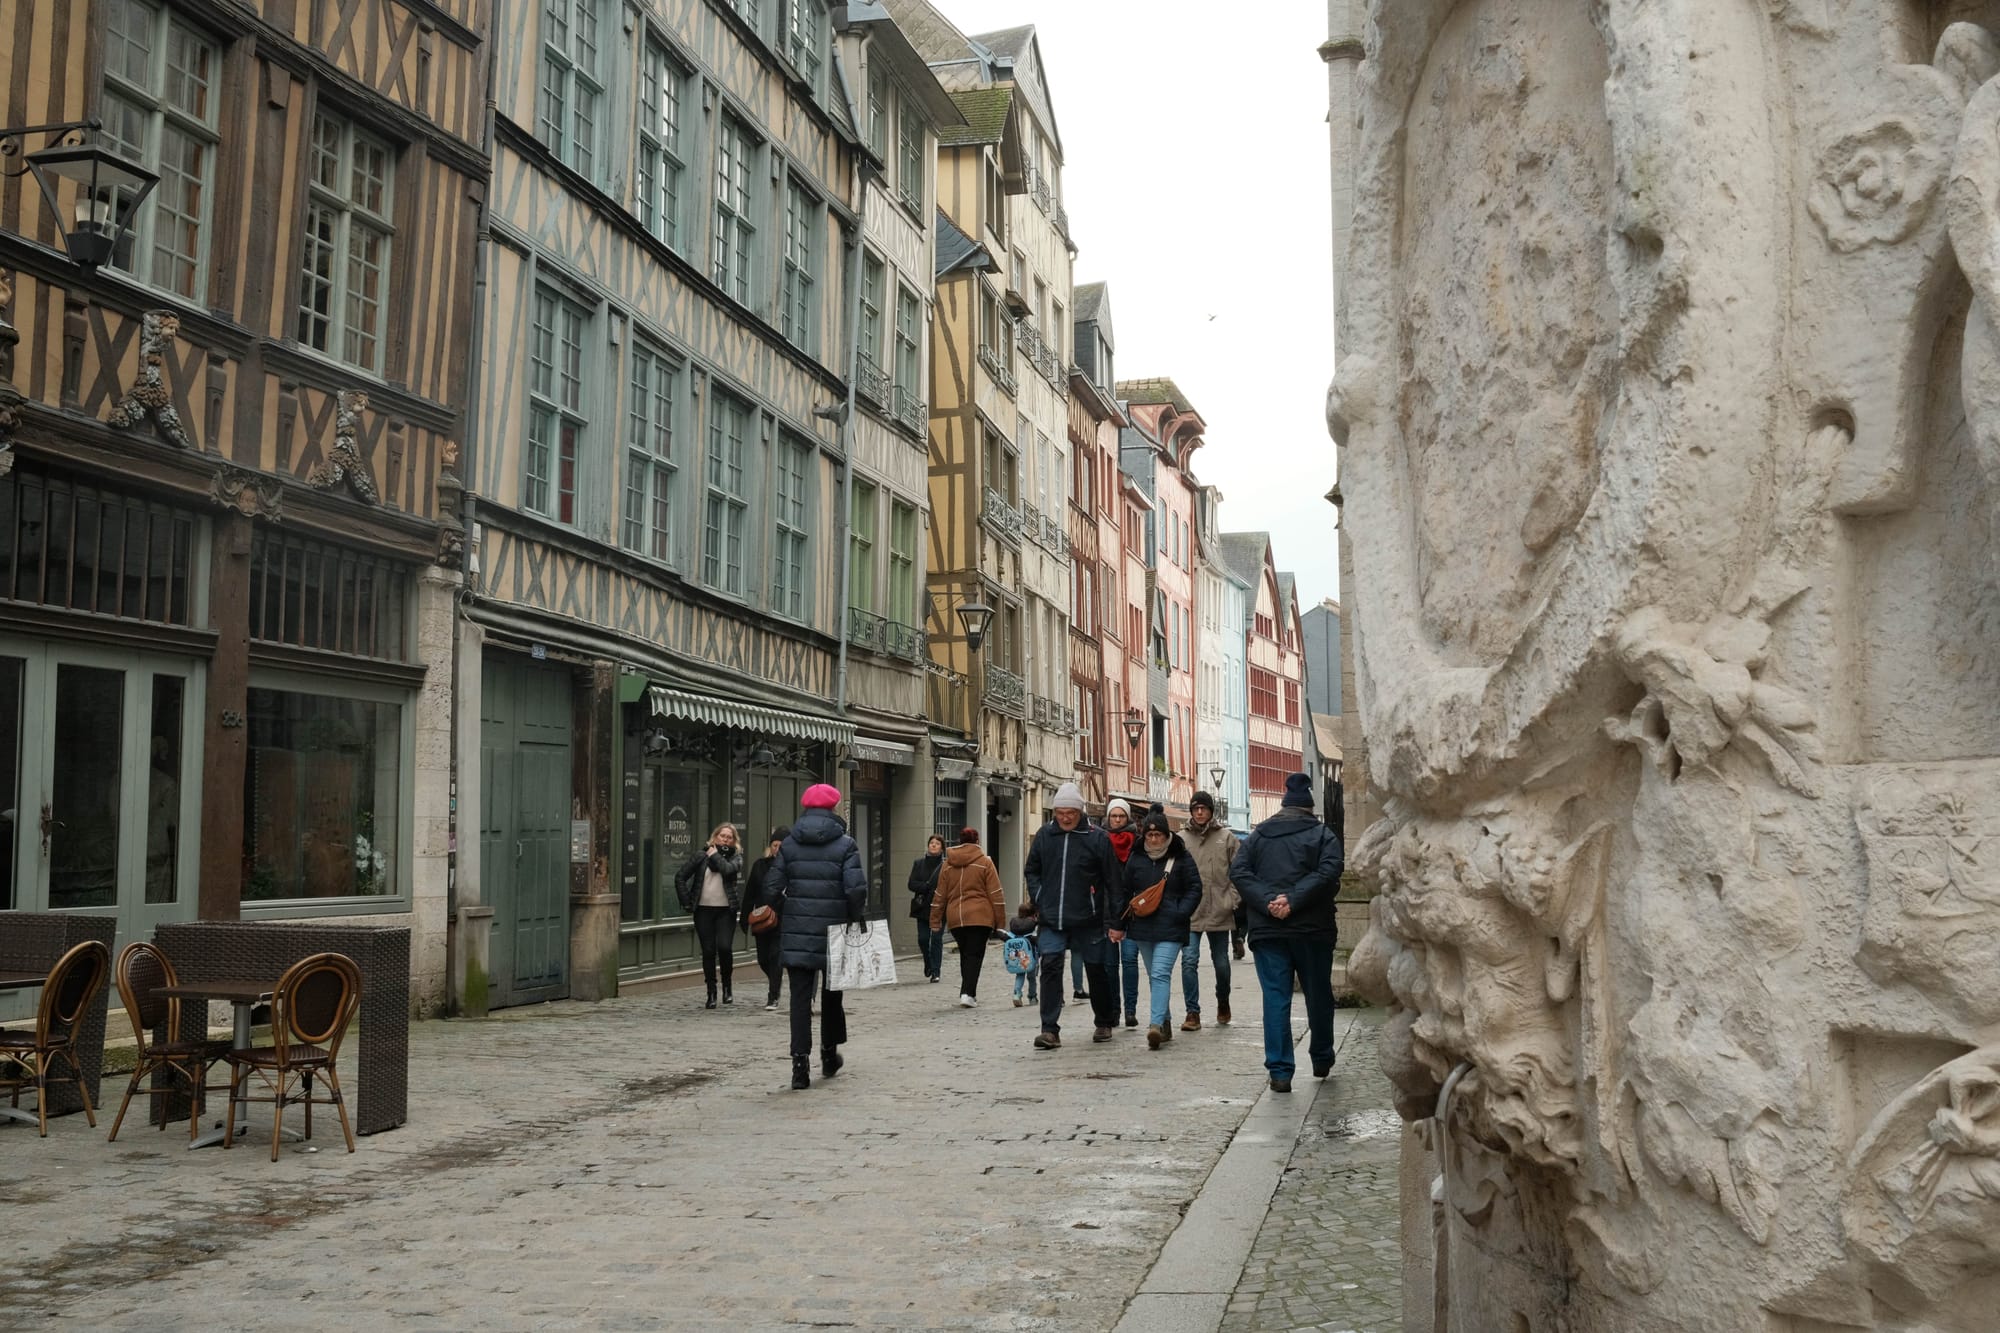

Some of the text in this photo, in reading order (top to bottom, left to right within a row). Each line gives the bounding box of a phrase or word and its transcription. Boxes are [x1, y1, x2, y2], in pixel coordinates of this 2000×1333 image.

[668, 820, 687, 831] BISTRO
[664, 834, 690, 845] ST MACLOU
